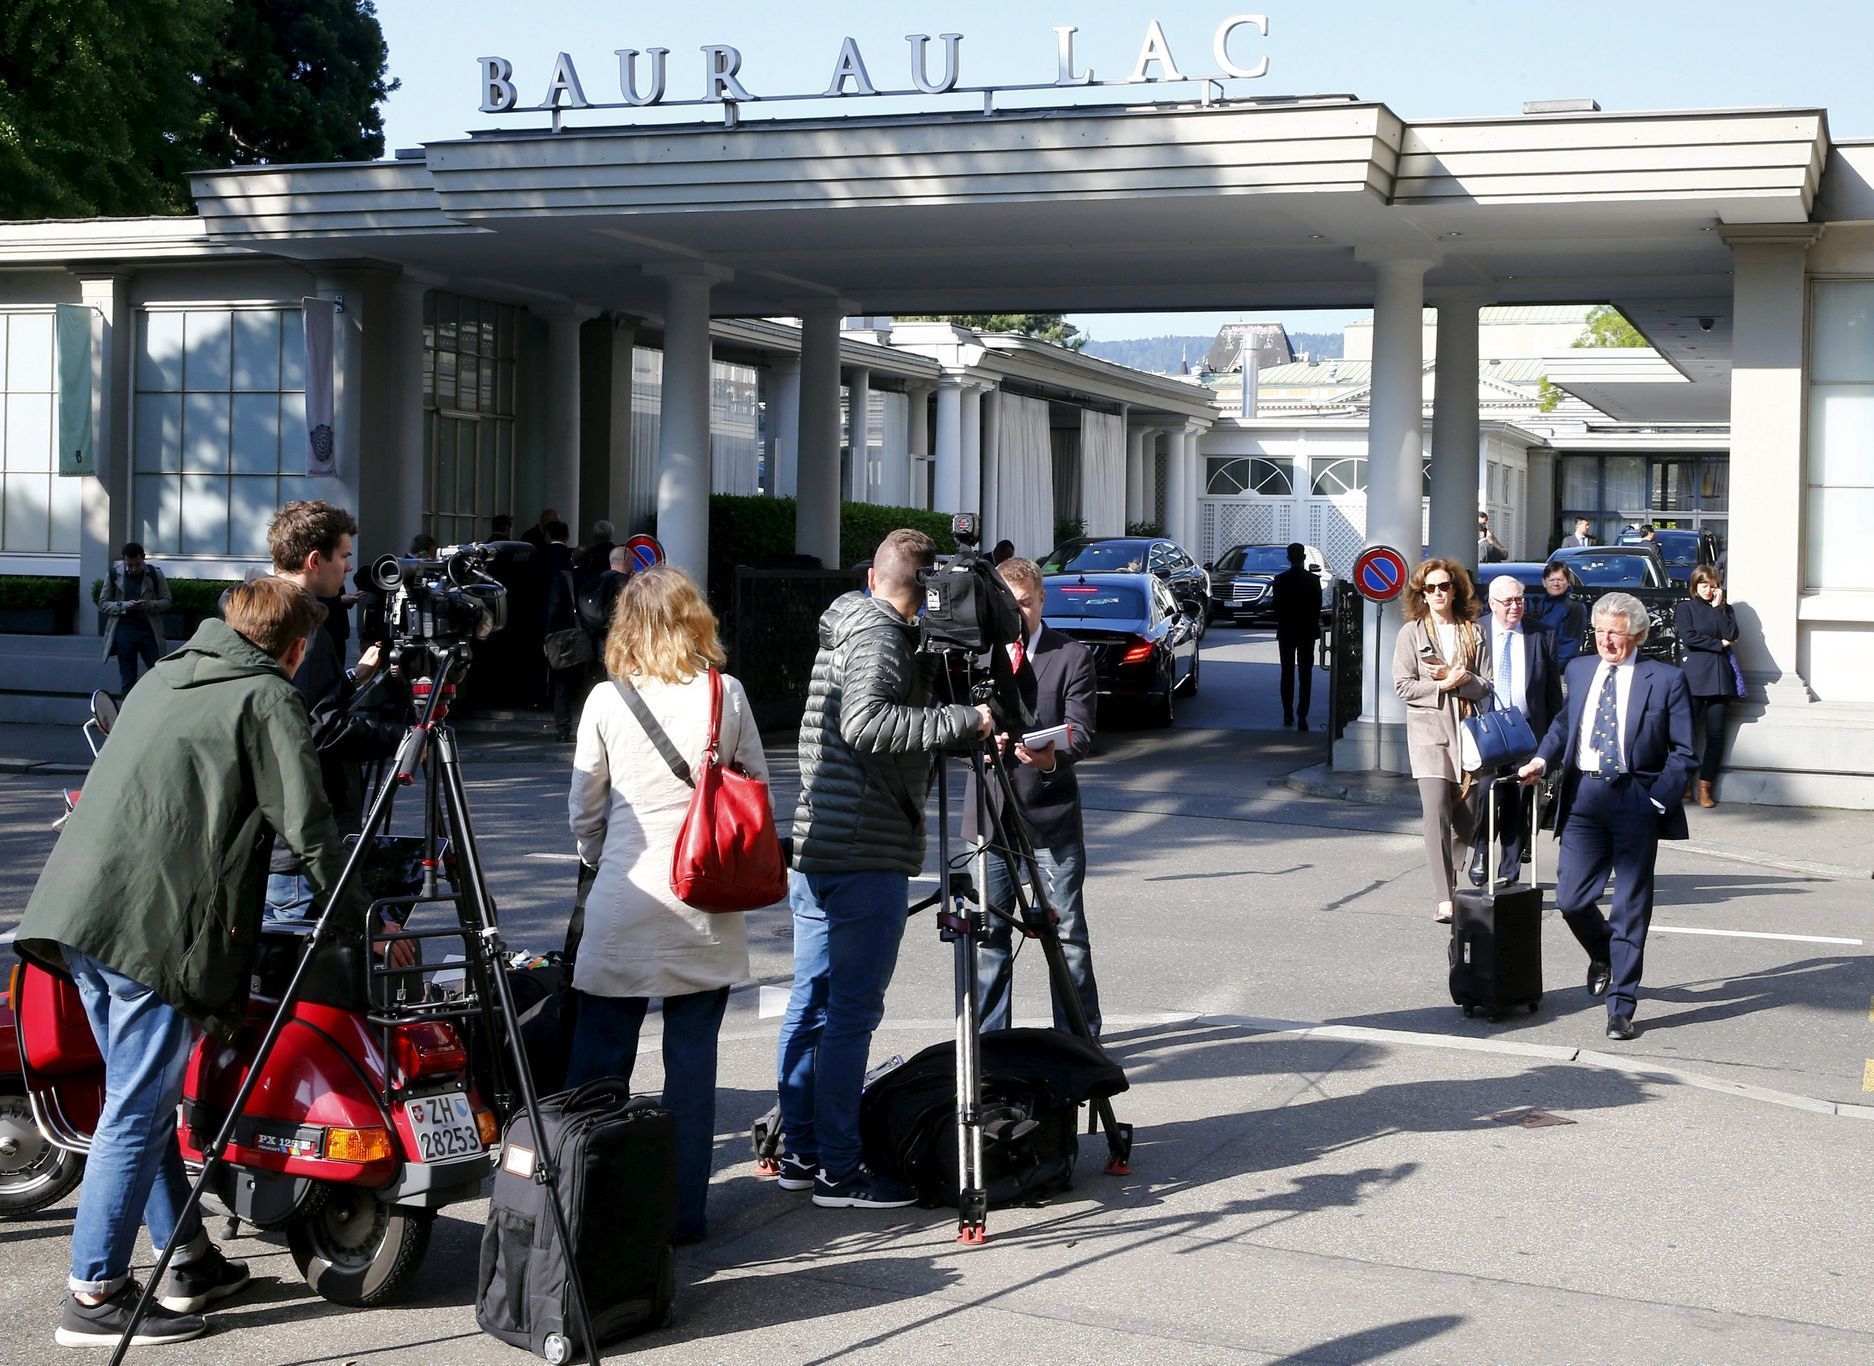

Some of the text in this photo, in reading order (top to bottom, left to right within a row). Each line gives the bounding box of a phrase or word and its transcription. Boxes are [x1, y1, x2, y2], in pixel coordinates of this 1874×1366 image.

[477, 14, 1269, 112] BAUR AU LAC
[426, 1097, 455, 1125] ZH
[258, 1134, 276, 1145] PX
[420, 1126, 479, 1159] 28253
